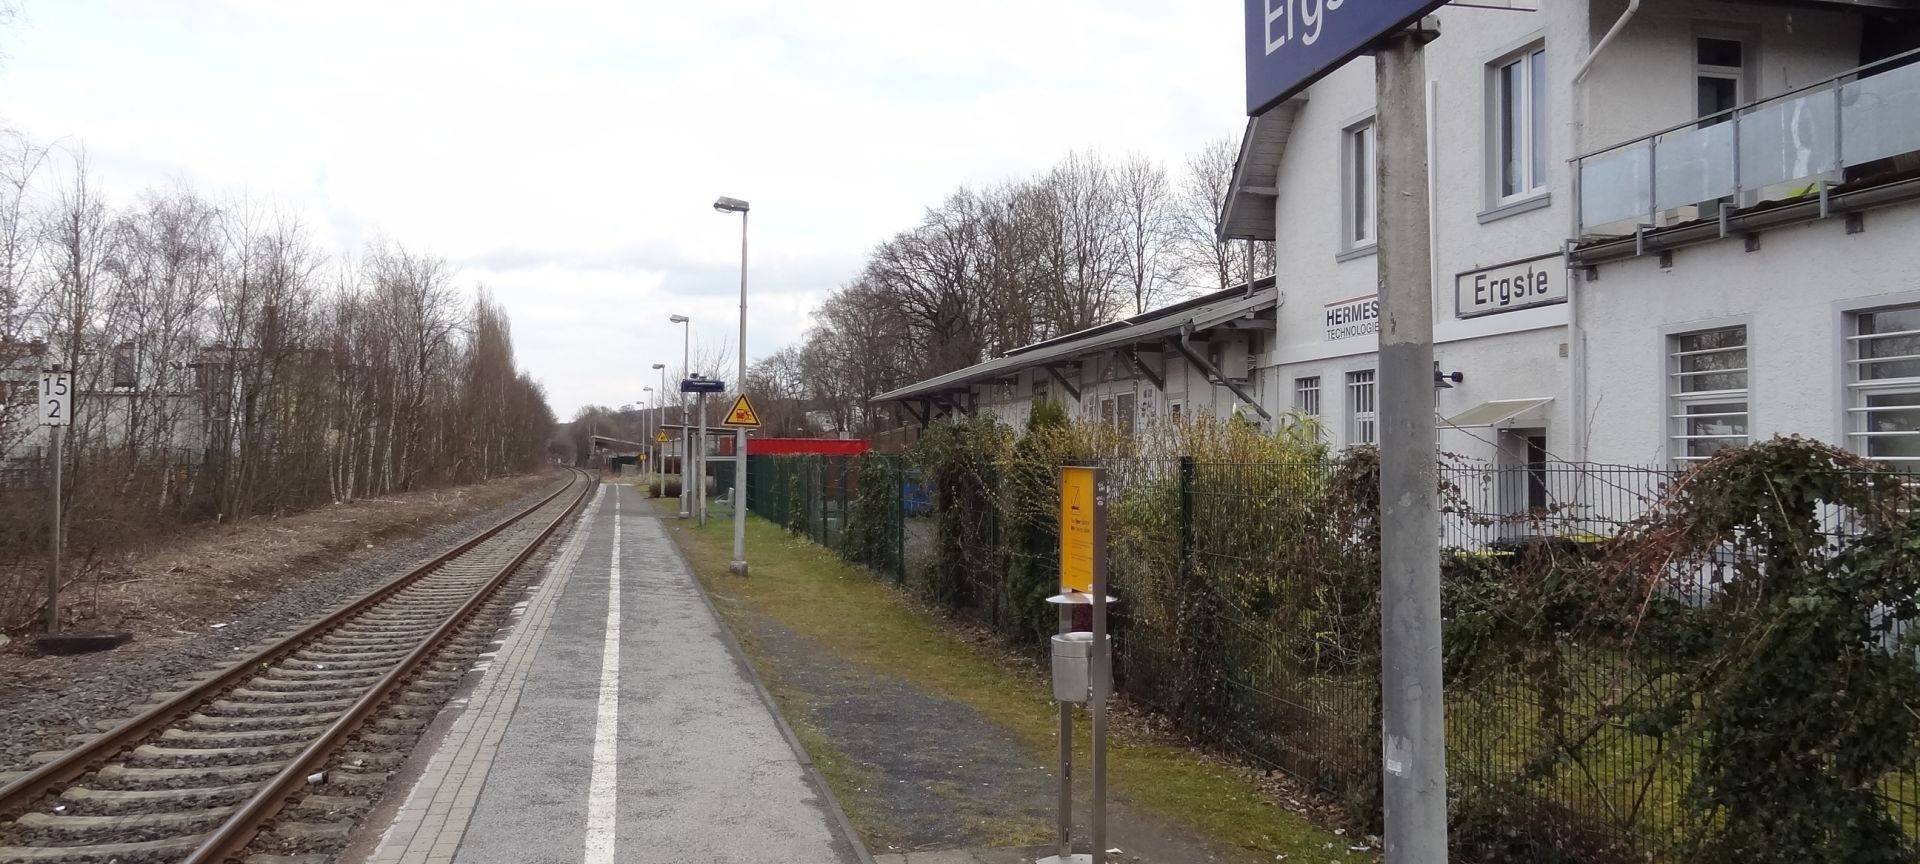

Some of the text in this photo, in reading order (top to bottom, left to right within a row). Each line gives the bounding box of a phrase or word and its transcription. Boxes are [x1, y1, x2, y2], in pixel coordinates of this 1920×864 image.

[1475, 264, 1548, 306] Ergste
[1326, 300, 1379, 327] HERMES
[43, 377, 68, 396] 15
[48, 399, 61, 418] 2
